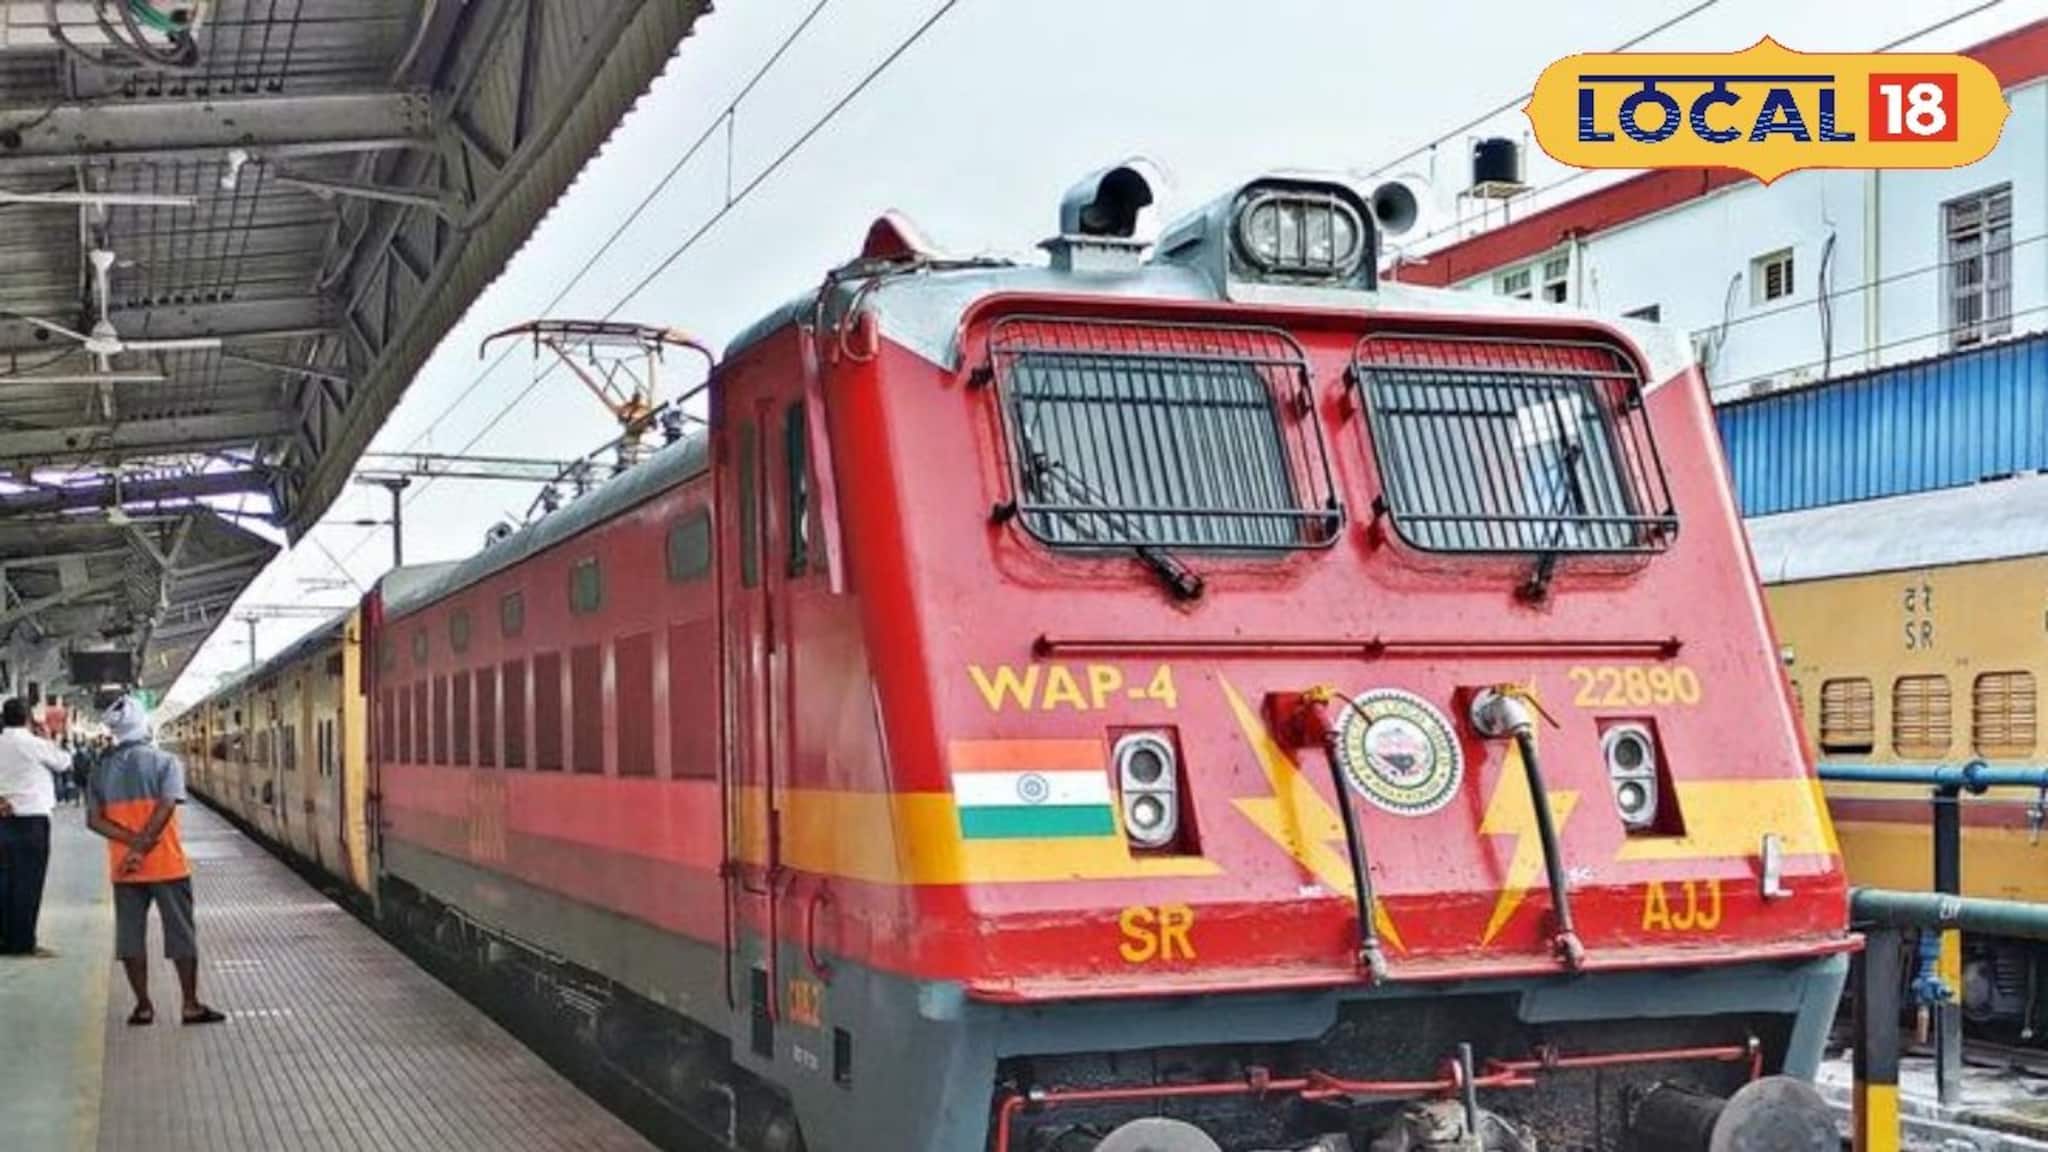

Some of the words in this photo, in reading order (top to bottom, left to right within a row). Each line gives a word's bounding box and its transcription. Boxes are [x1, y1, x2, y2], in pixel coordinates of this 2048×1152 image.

[1904, 620, 1933, 650] SR
[967, 664, 1178, 712] WAP-4
[1568, 665, 1702, 707] 22890
[1642, 879, 1721, 931] AJJ
[1119, 905, 1197, 963] SR
